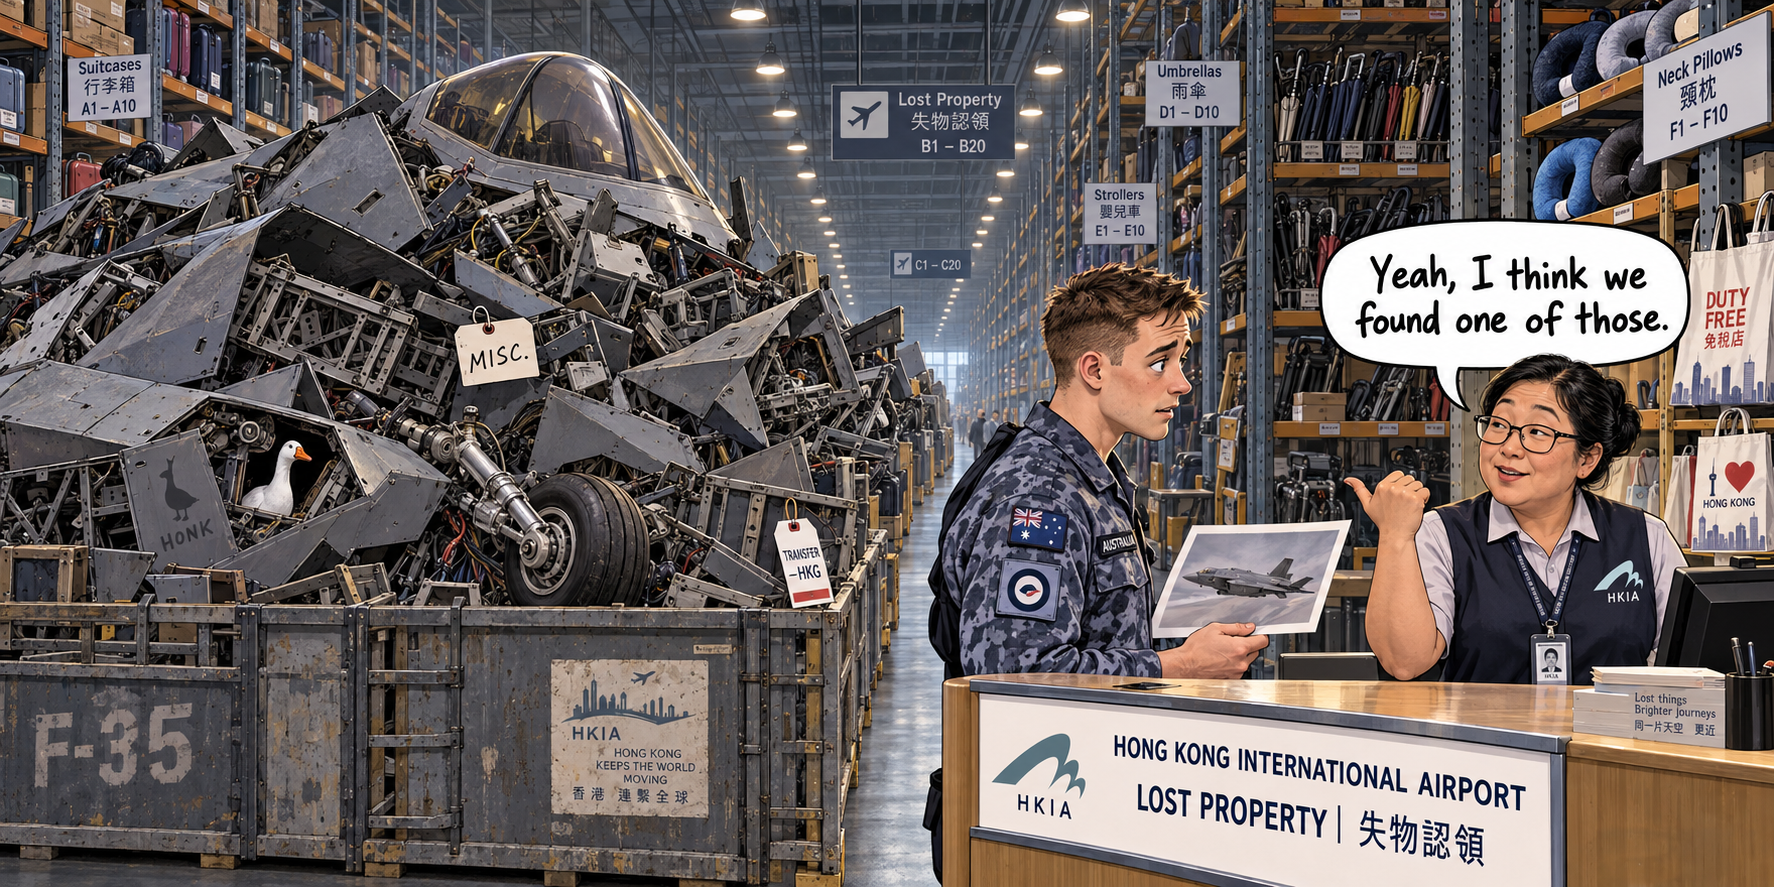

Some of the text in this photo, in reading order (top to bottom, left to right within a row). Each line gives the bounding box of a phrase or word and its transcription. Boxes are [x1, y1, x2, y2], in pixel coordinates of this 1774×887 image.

[78, 60, 142, 75] Suitcases
[1157, 64, 1222, 78] Umbrellas
[1658, 42, 1743, 89] Neck Pillows
[84, 75, 135, 96] 行李箱
[1171, 81, 1207, 100] 雨傘
[81, 101, 96, 116] A1
[112, 98, 136, 114] A10
[898, 92, 1002, 110] Lost Property
[1159, 105, 1175, 119] D1
[1195, 105, 1219, 119] D10
[911, 112, 990, 131] 失物認領
[1670, 119, 1684, 141] F1
[1703, 103, 1728, 129] F10
[921, 139, 938, 153] B1
[959, 139, 986, 153] B20
[1094, 188, 1145, 201] Strollers
[1100, 203, 1141, 219] 嬰兒車
[1095, 224, 1108, 237] E1
[1124, 224, 1145, 237] E10
[915, 259, 928, 271] C1
[941, 259, 961, 271] C20
[1706, 286, 1751, 310] DUTY
[1705, 308, 1747, 330] FREE
[469, 343, 529, 374] MISC.
[1702, 497, 1756, 509] HONG KONG
[160, 518, 214, 552] HONK
[782, 546, 821, 562] TRANSFER
[1607, 591, 1640, 603] HKIA
[1634, 692, 1687, 706] Lost things
[1634, 704, 1673, 717] Brighter
[572, 726, 621, 741] HKIA
[1694, 723, 1716, 737] 更近
[34, 702, 193, 788] F-35
[614, 748, 682, 759] HONG KONG
[596, 760, 696, 772] KEEPS THE WORLD
[1114, 734, 1526, 811] HONG KONG INTERNATIONAL AIRPORT
[623, 774, 668, 785] MOVING
[572, 786, 605, 801] 香港
[1017, 793, 1072, 820] HKIA
[1137, 783, 1486, 867] LOST PROPERTY 失物認領
